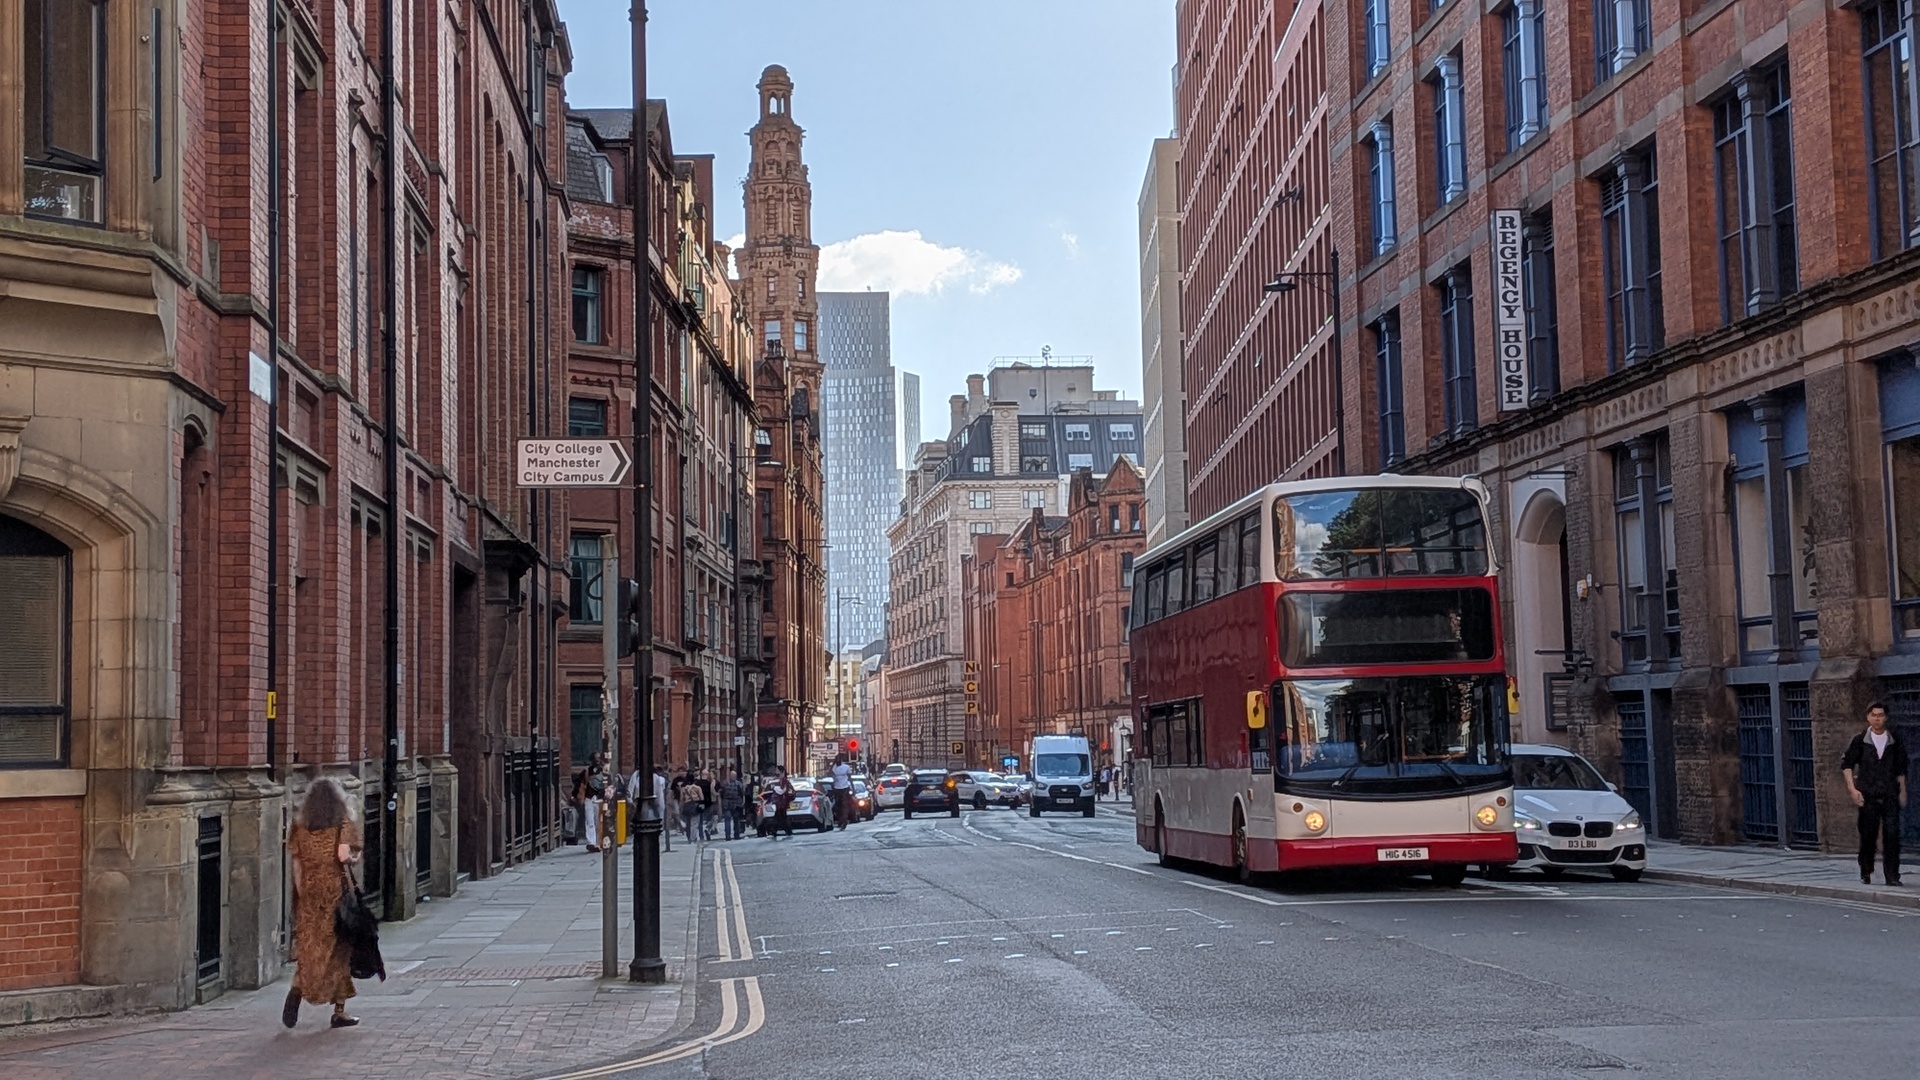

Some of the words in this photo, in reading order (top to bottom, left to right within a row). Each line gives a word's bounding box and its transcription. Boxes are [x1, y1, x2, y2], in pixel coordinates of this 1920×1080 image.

[1498, 215, 1521, 319] REGENCY
[1501, 329, 1523, 404] HOUSE
[524, 443, 551, 456] City
[555, 443, 603, 456] College
[527, 457, 601, 468] Manchester
[523, 471, 550, 484] City
[553, 471, 605, 484] Campus
[965, 662, 976, 713] NCP
[1568, 840, 1579, 848] D3
[1580, 840, 1597, 848] LBU
[1385, 849, 1400, 859] HIG
[1401, 848, 1422, 859] 4516
